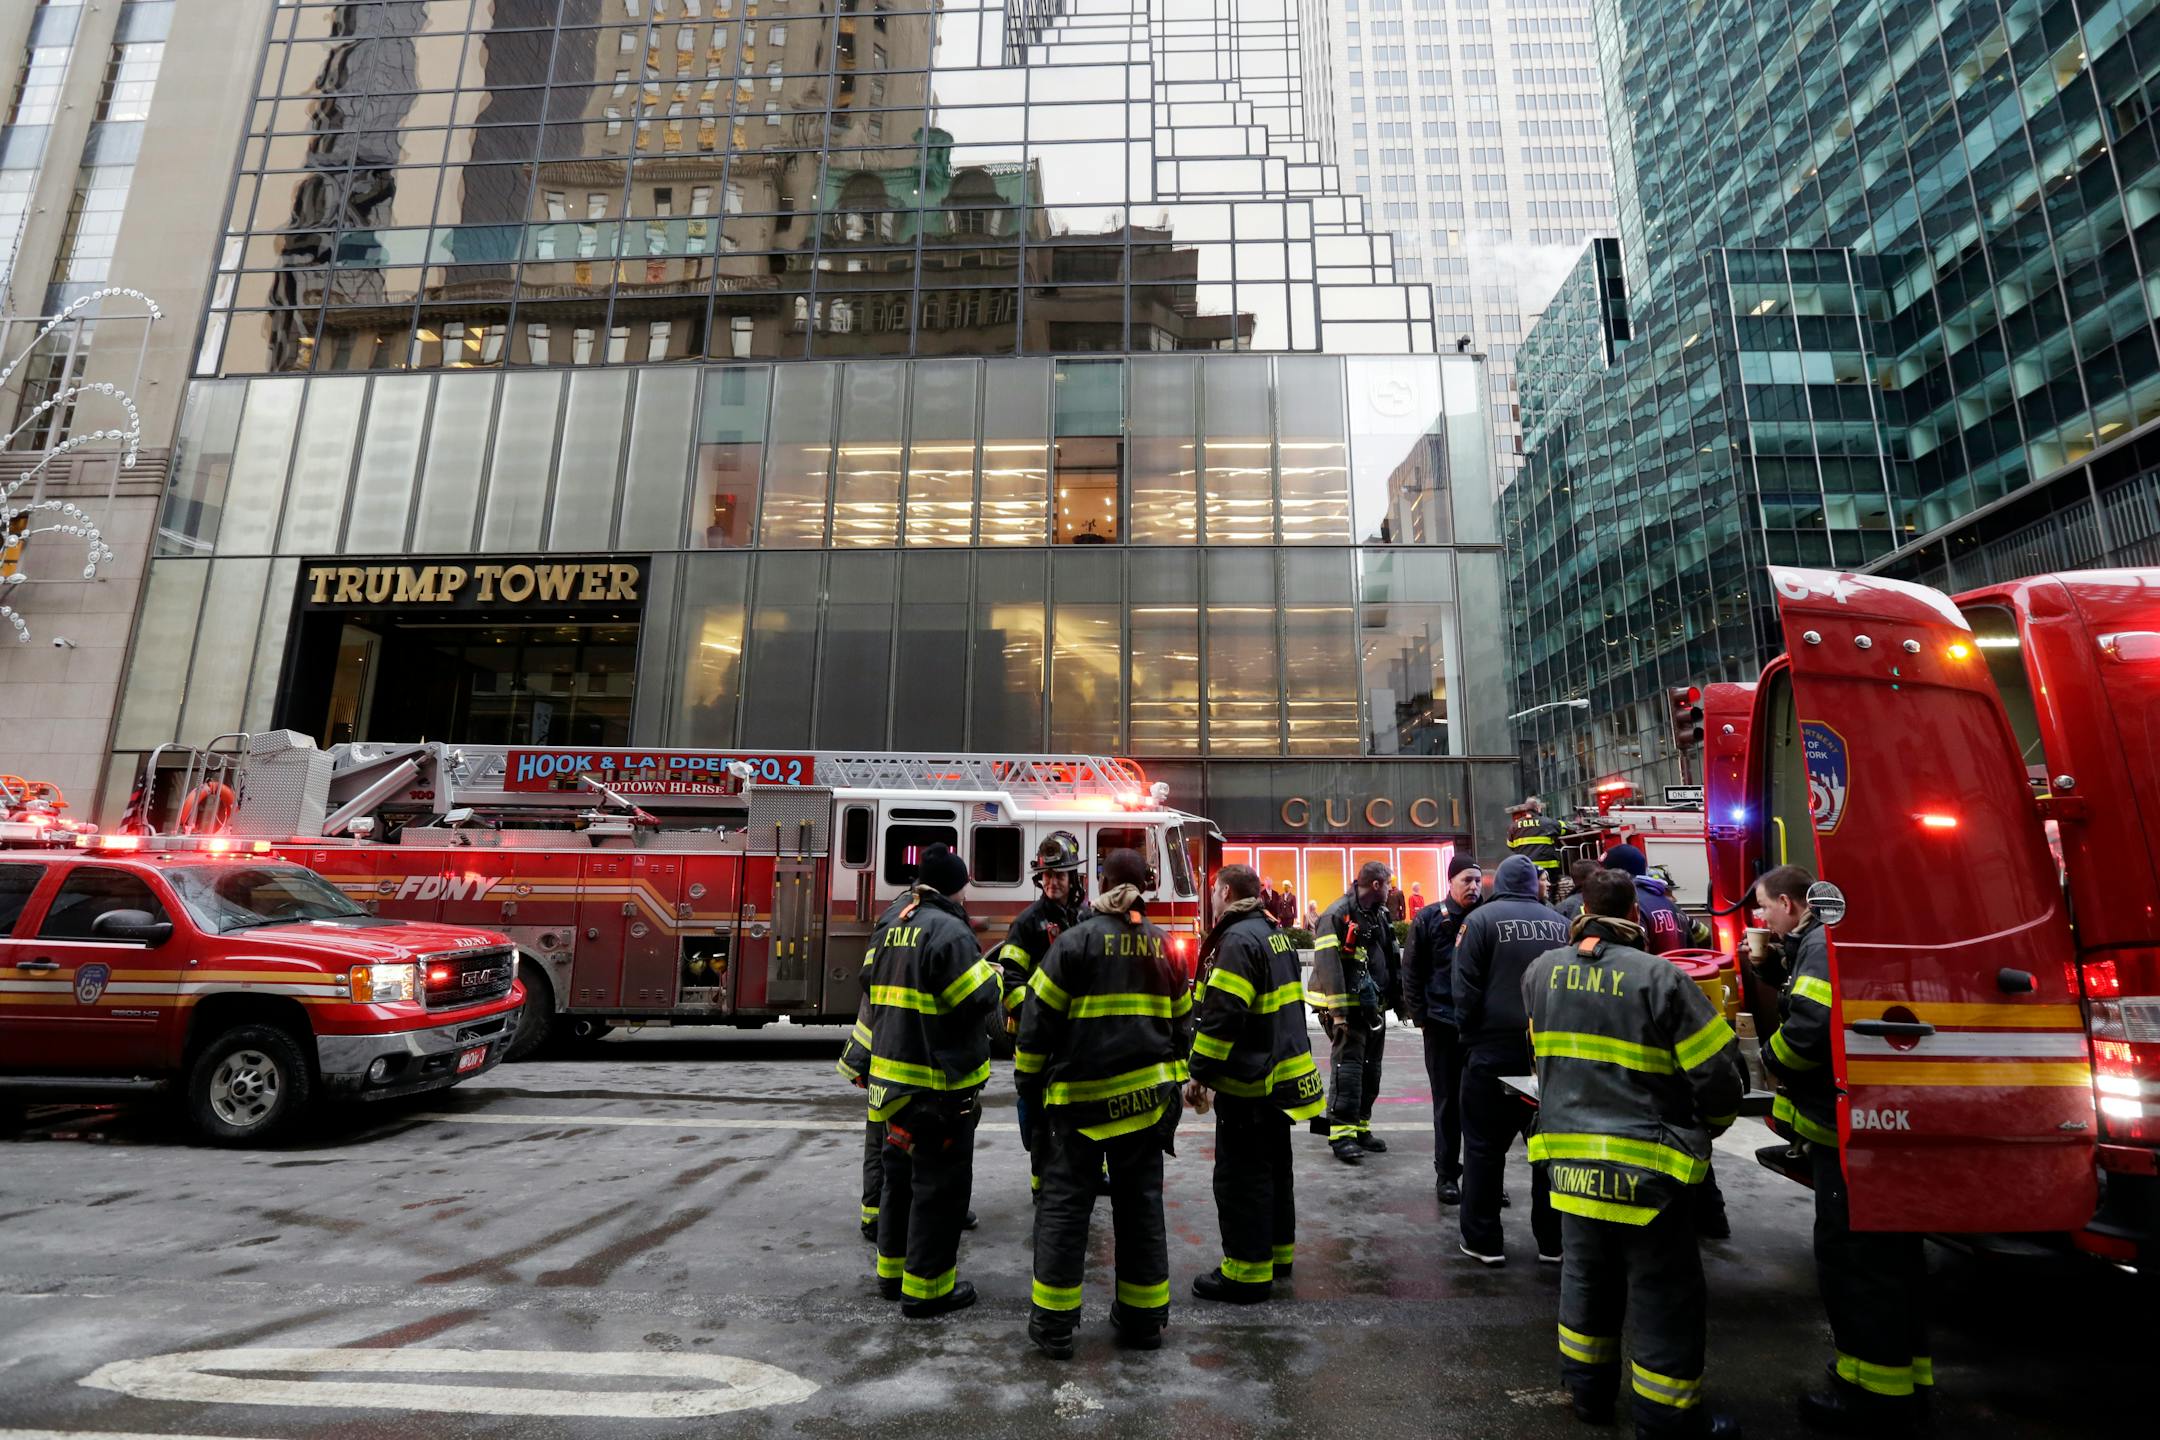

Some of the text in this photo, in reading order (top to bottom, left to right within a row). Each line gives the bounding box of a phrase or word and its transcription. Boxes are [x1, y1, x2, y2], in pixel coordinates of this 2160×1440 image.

[308, 563, 640, 603] TRUMP TOWER
[1807, 740, 1820, 749] OF
[517, 754, 593, 782] HOOK
[599, 756, 616, 769] &
[409, 790, 435, 800] 100
[592, 780, 725, 794] IDTOWN HI-RISE
[1672, 791, 1687, 799] ONE
[1281, 797, 1461, 828] GUCCI
[395, 875, 502, 901] FDNY
[1496, 919, 1567, 943] FDNY
[1651, 909, 1684, 934] FD
[1103, 933, 1165, 960] F.D.N.Y.
[461, 969, 497, 988] GMC
[1550, 964, 1625, 997] F.D.N.Y.
[479, 1047, 487, 1064] 3
[1107, 1085, 1161, 1119] GRANT
[1850, 1108, 1912, 1131] BACK
[1553, 1165, 1639, 1201] DONNELLY
